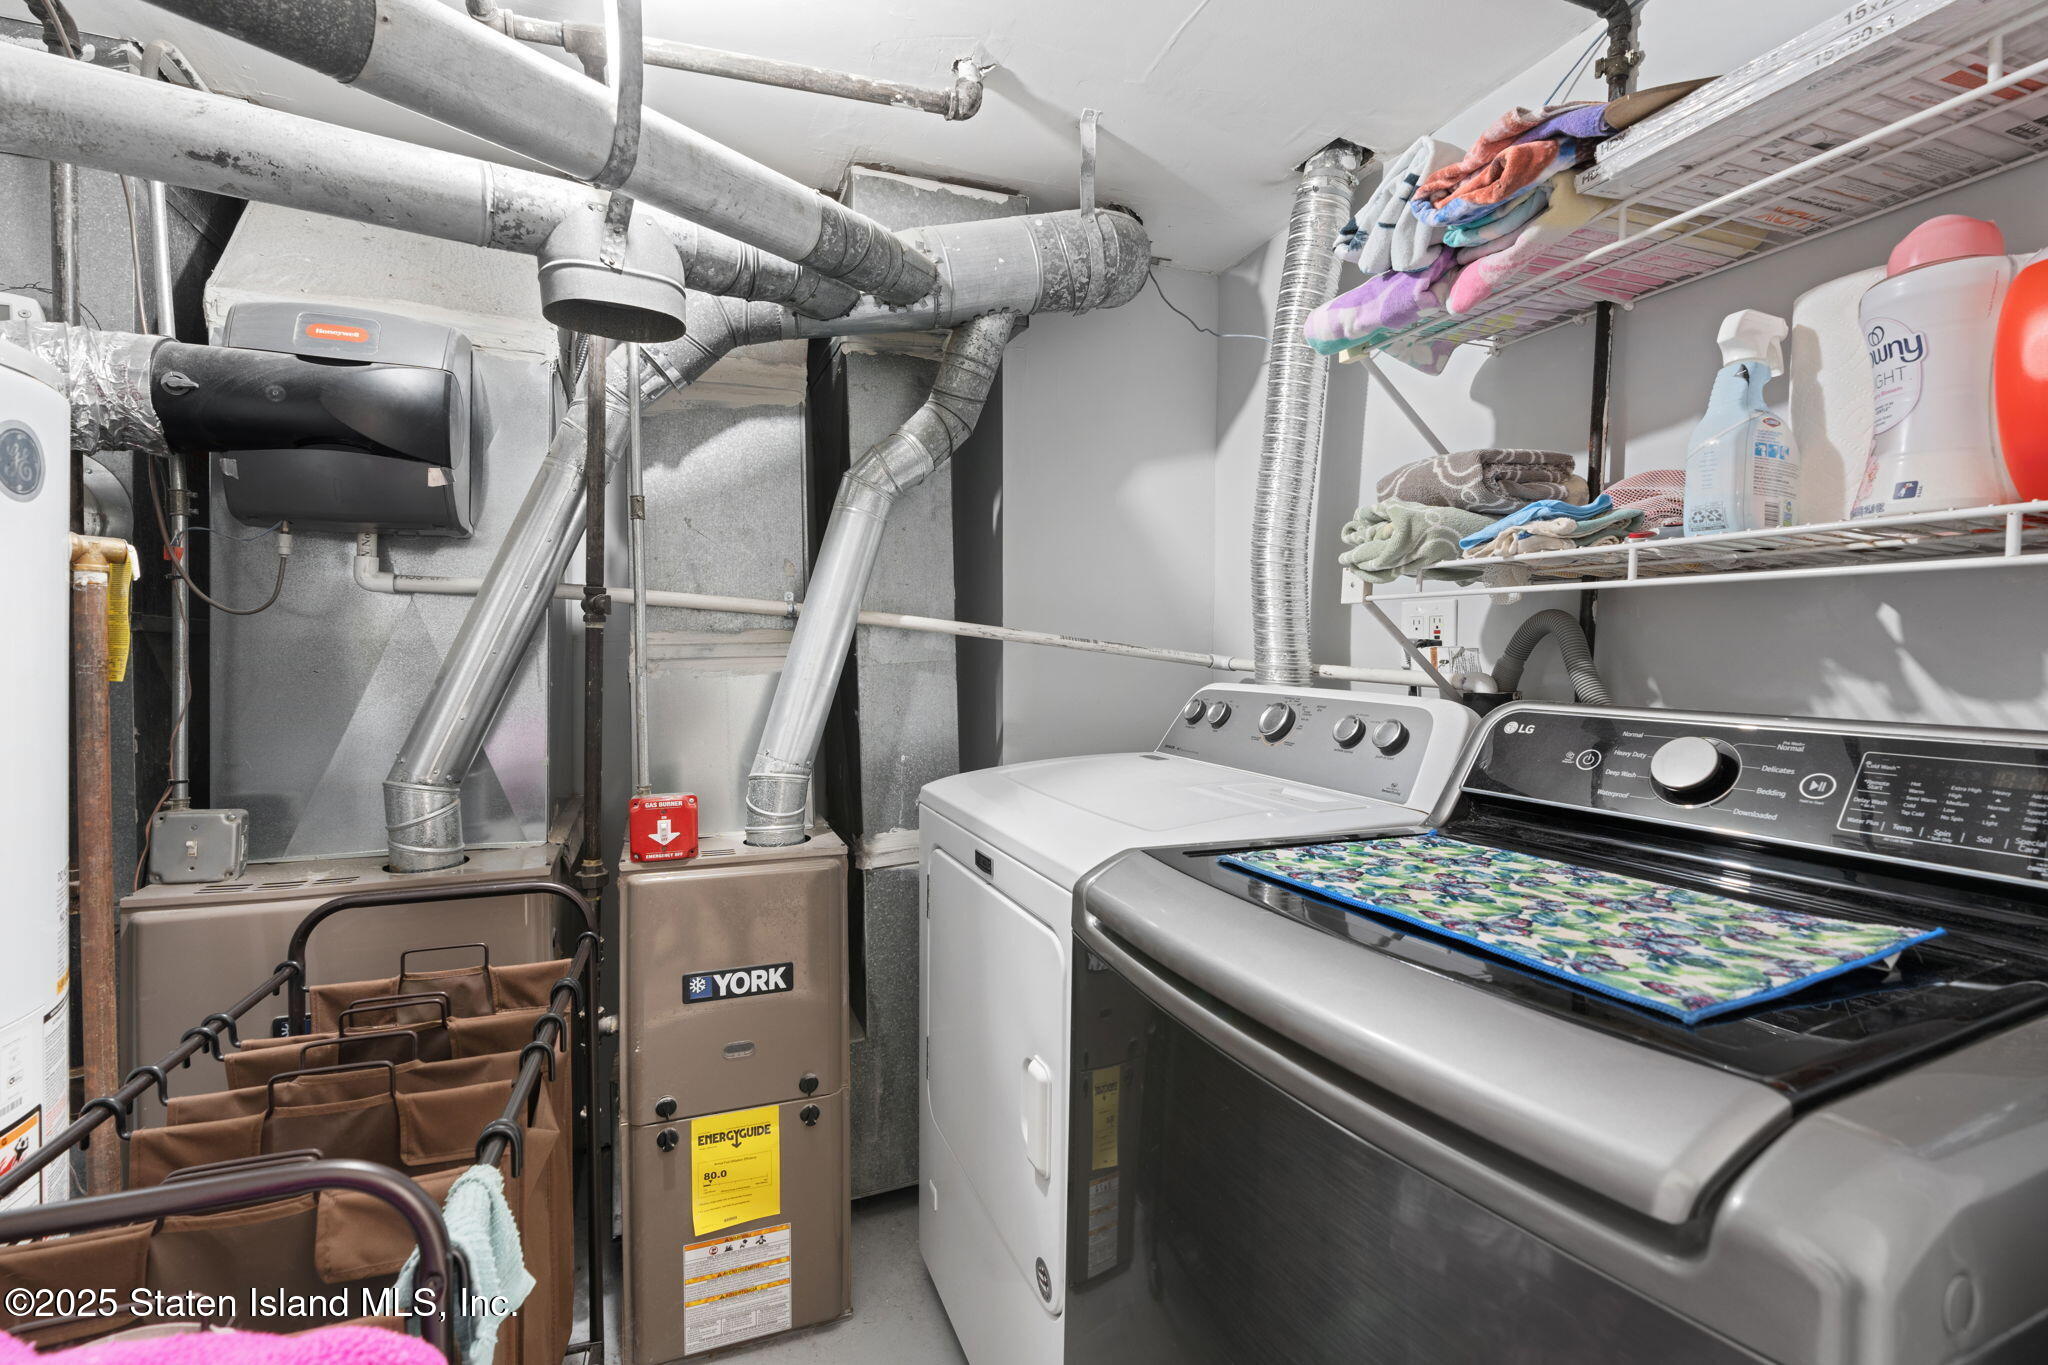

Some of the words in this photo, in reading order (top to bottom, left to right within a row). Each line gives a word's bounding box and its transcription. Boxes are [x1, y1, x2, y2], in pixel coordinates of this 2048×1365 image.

[315, 327, 360, 338] Honeywell
[1518, 724, 1535, 734] LG
[1776, 744, 1805, 752] Normal
[1614, 749, 1631, 758] Heavy
[1632, 751, 1647, 759] Duty
[1605, 768, 1620, 777] Deep
[1620, 770, 1637, 778] Wash
[1761, 765, 1796, 775] Delicates
[1597, 789, 1630, 798] Waterproof
[1756, 787, 1786, 799] Bedding
[1967, 786, 1982, 794] High
[1732, 808, 1778, 820] Downloaded
[1933, 829, 1952, 838] Spin
[1976, 835, 1993, 844] Soil
[2015, 837, 2047, 848] Special
[2017, 845, 2040, 854] Care
[713, 967, 787, 997] YORK
[697, 1123, 772, 1147] ENERGYGUIDE
[703, 1169, 728, 1181] 80.0
